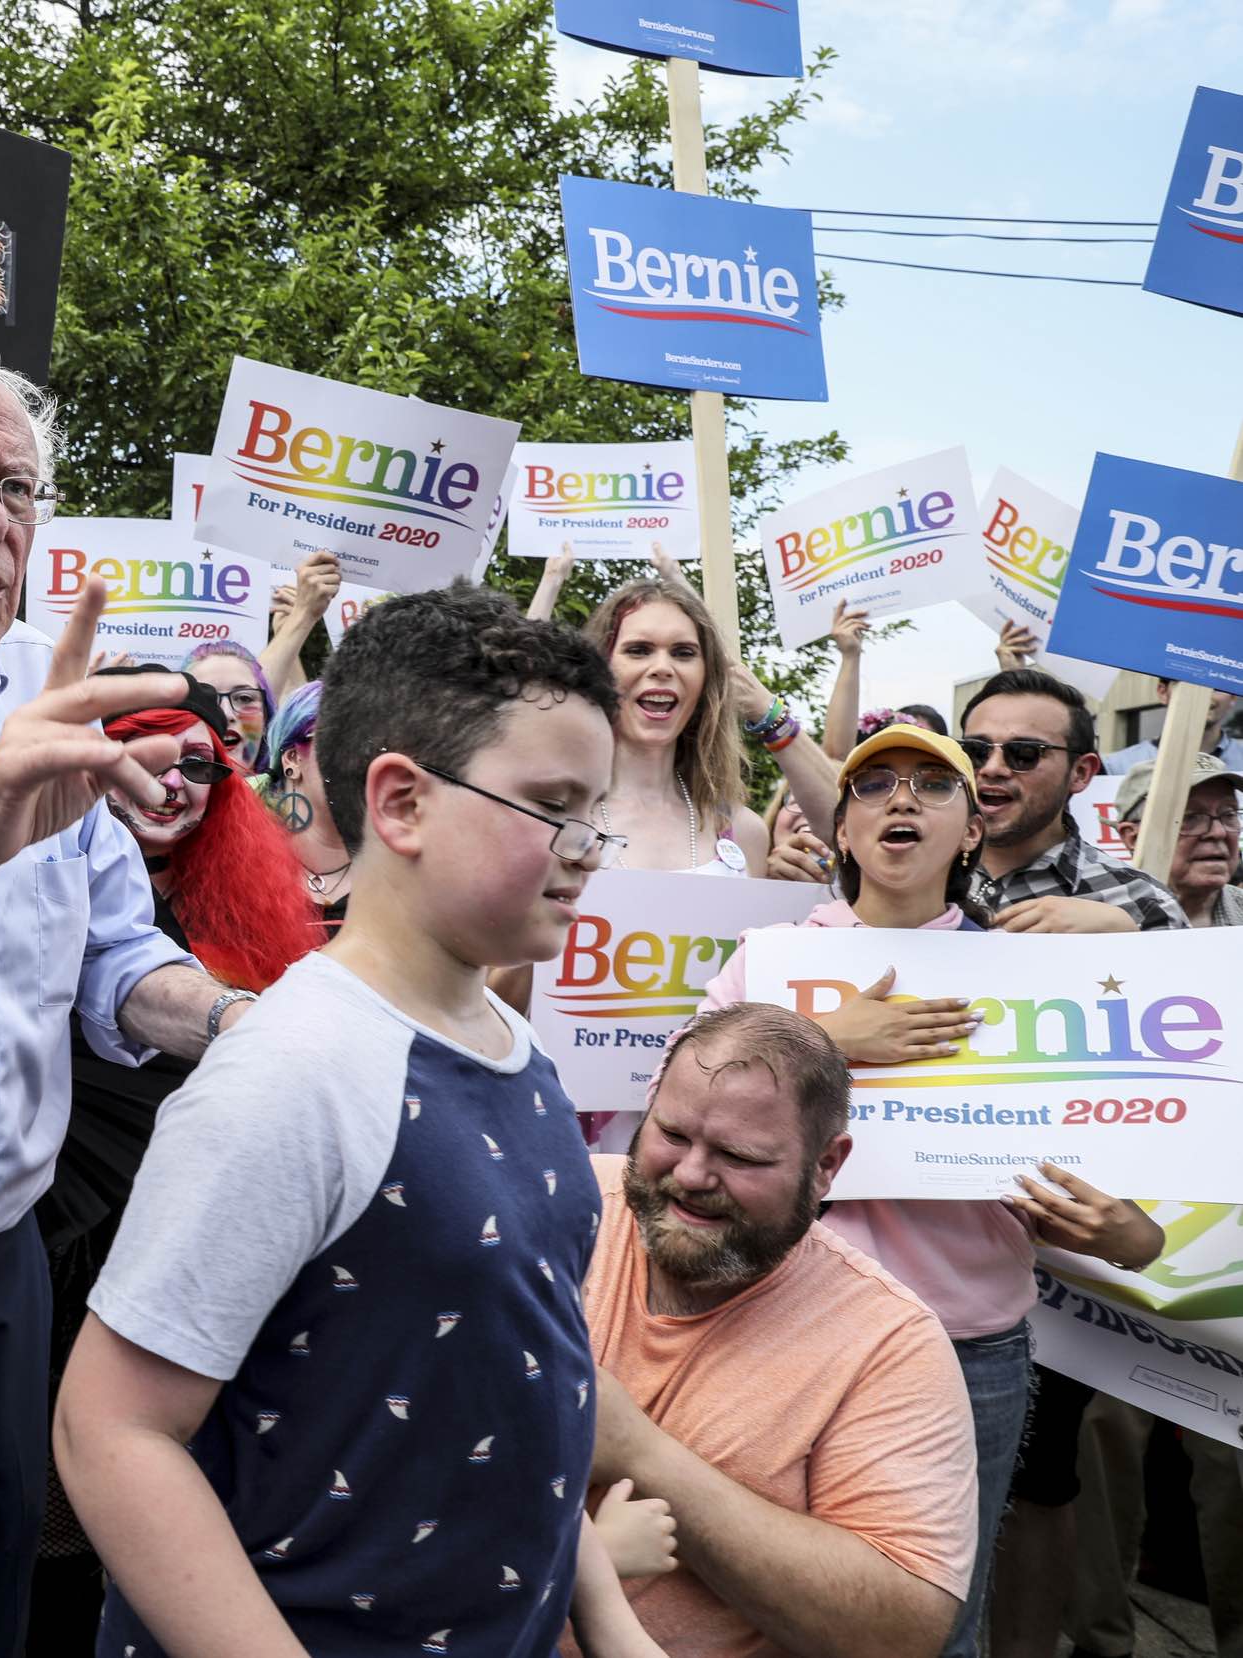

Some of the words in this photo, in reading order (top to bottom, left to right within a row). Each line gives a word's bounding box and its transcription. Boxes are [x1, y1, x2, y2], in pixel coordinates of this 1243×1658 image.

[638, 18, 716, 42] BernieSanders.com
[589, 227, 799, 318] Bernie
[664, 352, 742, 371] BernieSanders.com
[237, 400, 479, 512] Bernie
[524, 463, 684, 501] Bernie
[247, 491, 281, 513] For
[282, 501, 377, 538] President
[378, 522, 440, 549] 2020
[538, 517, 561, 529] For
[562, 517, 624, 529] President
[626, 516, 669, 529] 2020
[775, 486, 955, 579] Bernie
[47, 547, 251, 605] Bernie
[798, 589, 817, 606] For
[817, 565, 886, 597] President
[889, 549, 943, 575] 2020
[994, 576, 1047, 620] President
[96, 621, 174, 637] President
[177, 622, 230, 640] 2020
[574, 1027, 610, 1047] For
[849, 1104, 876, 1121] or
[882, 1099, 1052, 1126] President
[1062, 1097, 1187, 1125] 2020
[914, 1151, 1082, 1166] BernieSanderscom
